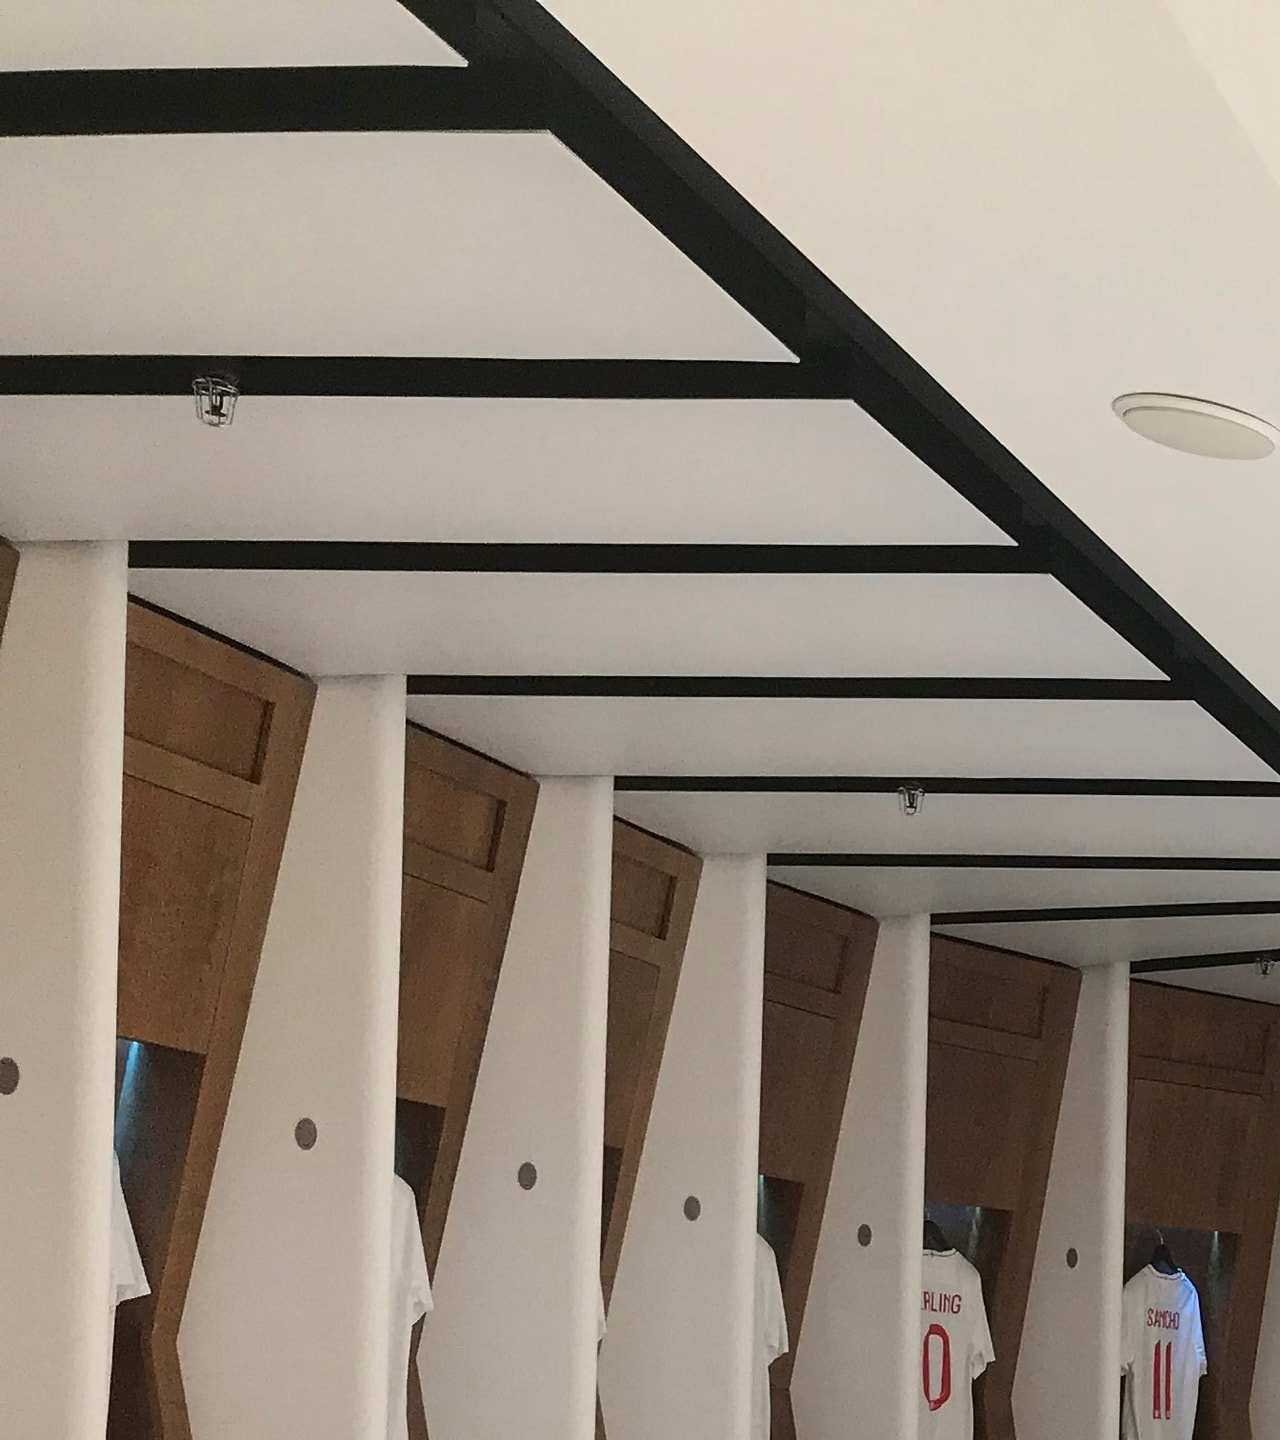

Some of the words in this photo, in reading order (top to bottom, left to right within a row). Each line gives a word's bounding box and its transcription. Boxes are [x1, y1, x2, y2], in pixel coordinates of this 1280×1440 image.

[921, 1291, 962, 1314] RLING
[1146, 1307, 1180, 1330] SANCHO
[1152, 1339, 1172, 1420] 11
